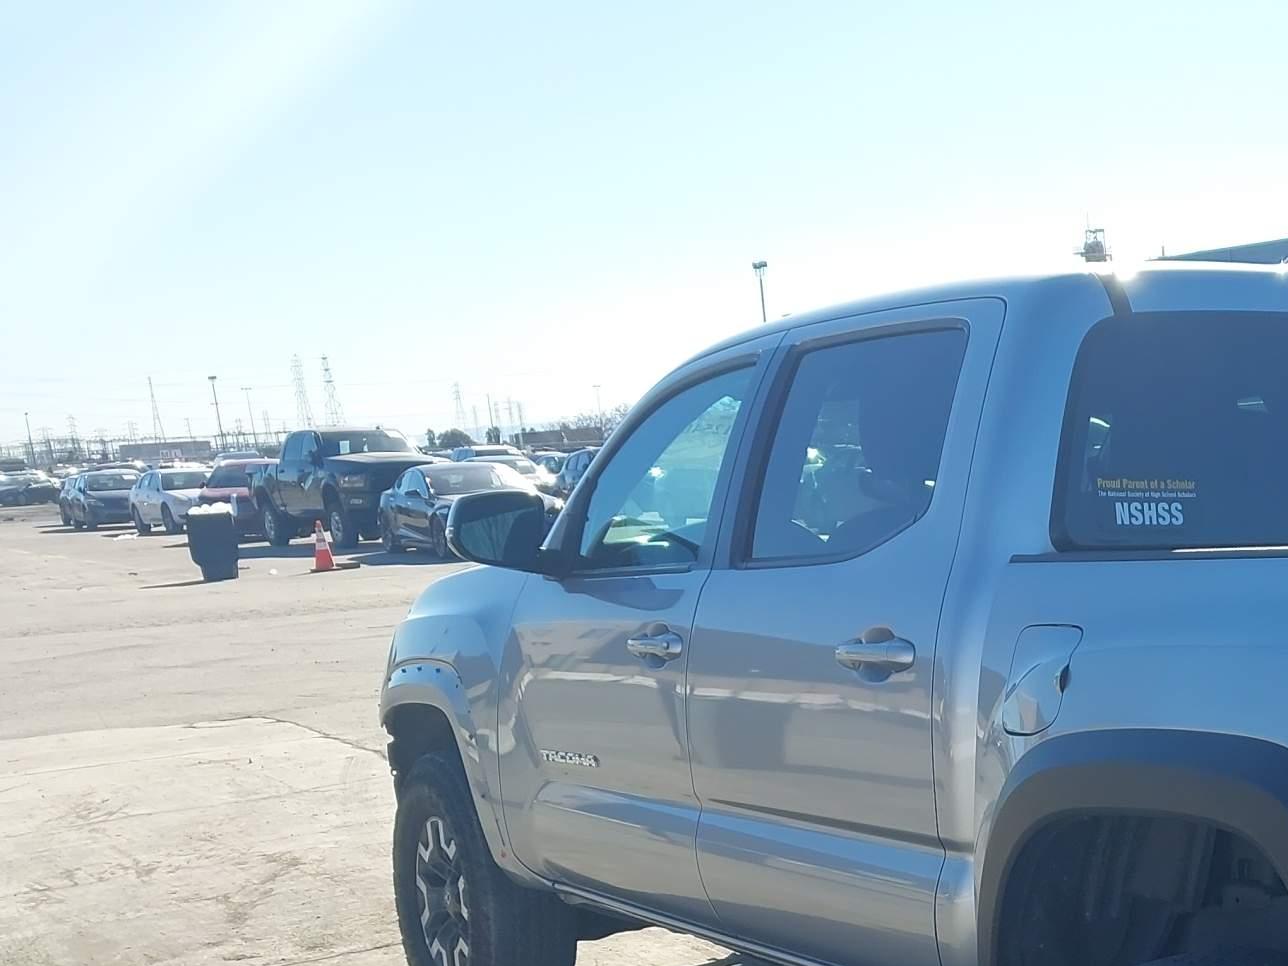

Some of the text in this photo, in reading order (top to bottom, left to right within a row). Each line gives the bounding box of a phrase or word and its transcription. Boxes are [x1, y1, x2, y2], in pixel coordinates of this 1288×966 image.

[1097, 478, 1121, 489] Proud
[1122, 478, 1149, 490] Parent
[1150, 479, 1158, 489] of
[1167, 479, 1196, 490] Scholar
[1115, 502, 1184, 525] NSHSS
[539, 749, 599, 769] TACOMA
